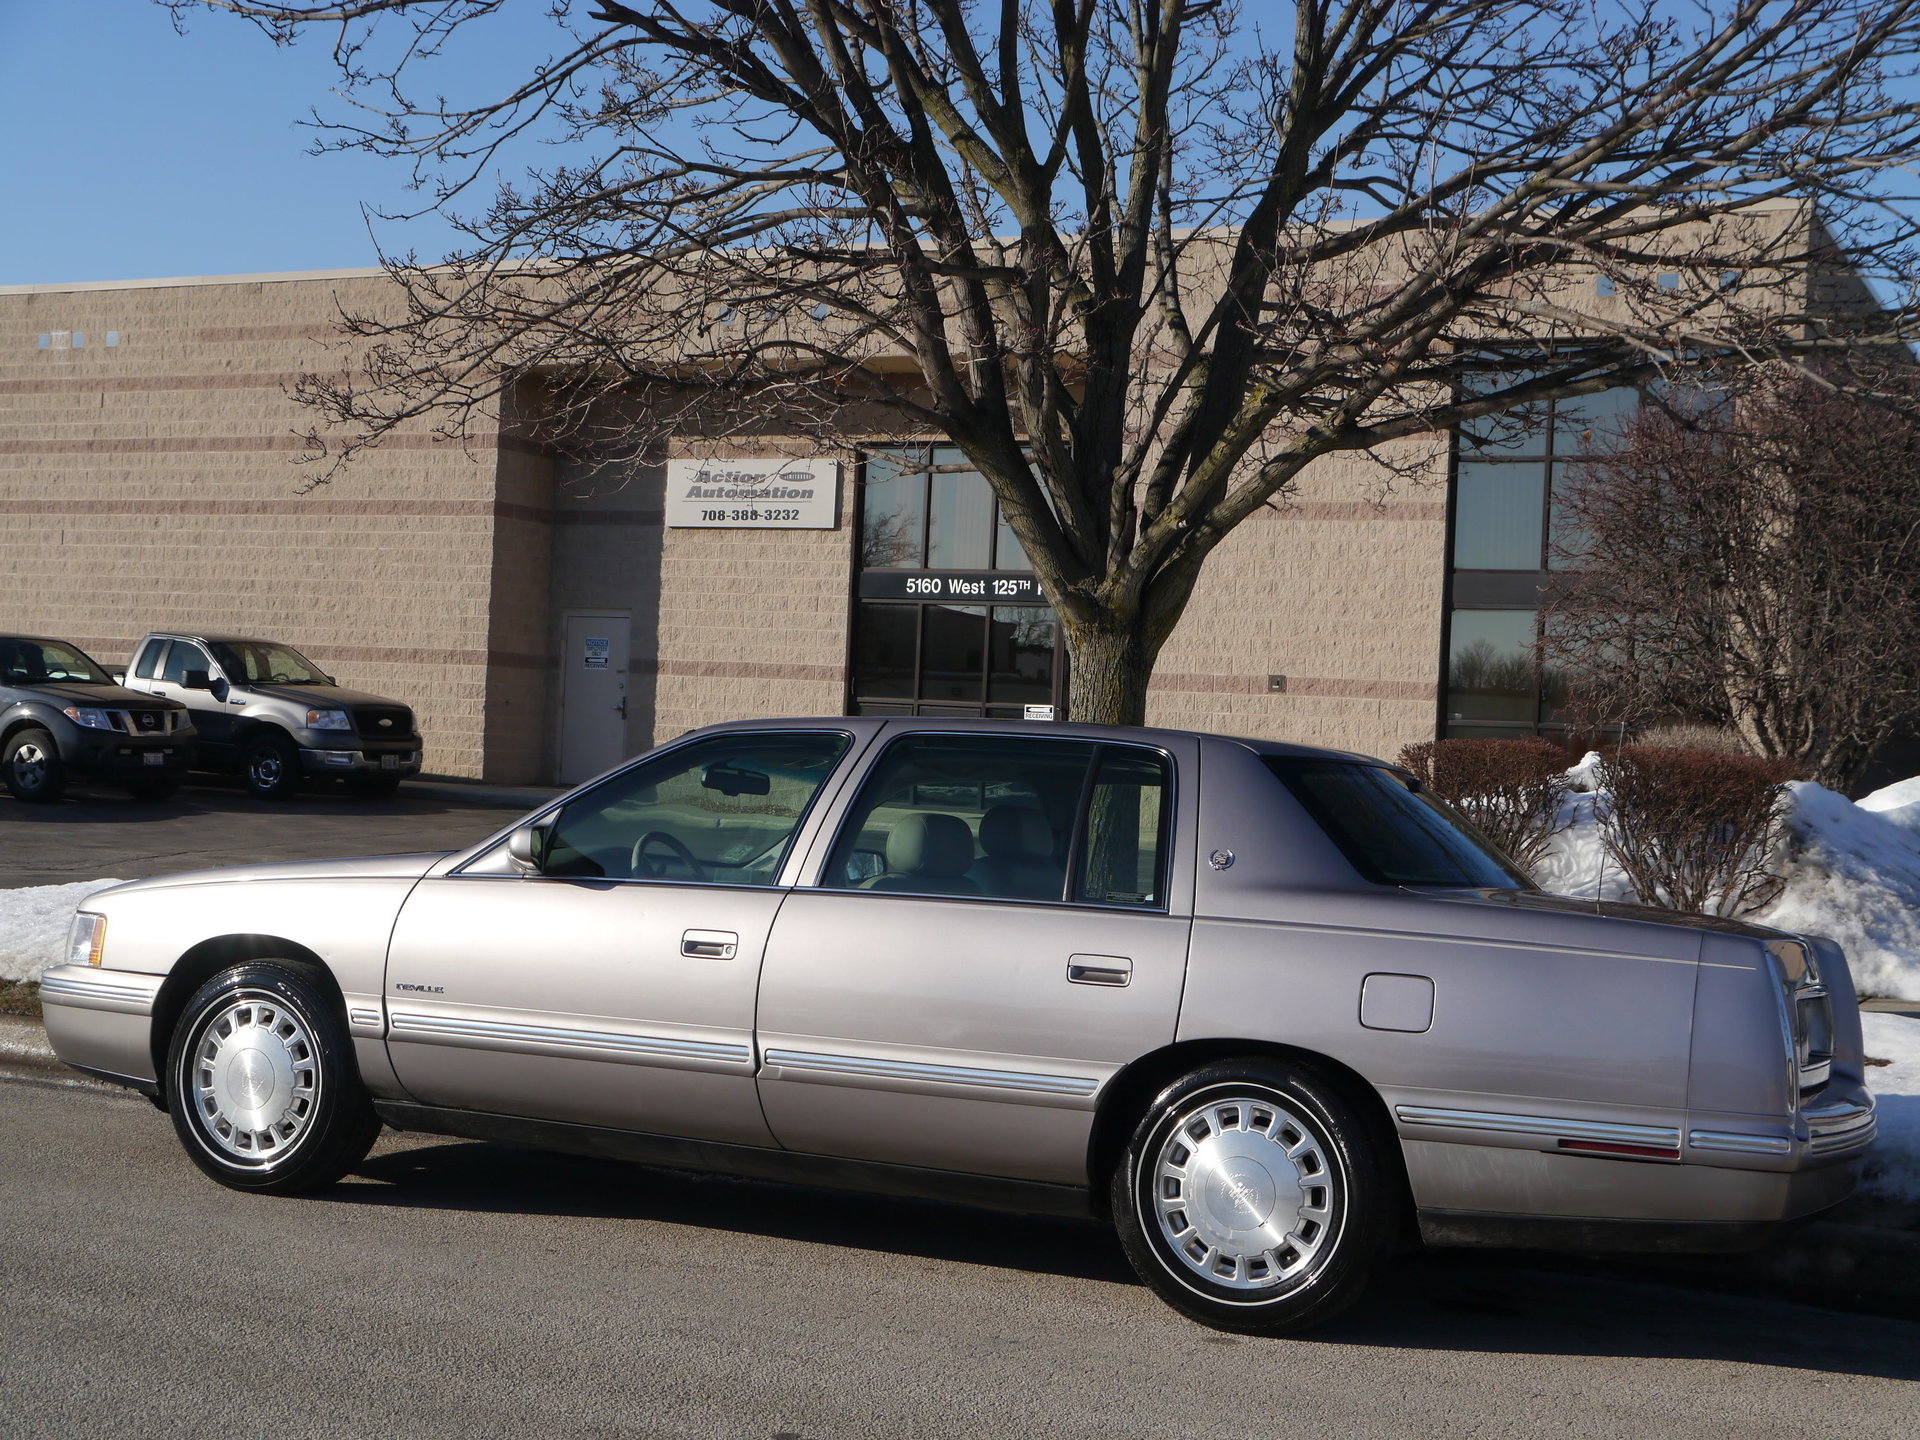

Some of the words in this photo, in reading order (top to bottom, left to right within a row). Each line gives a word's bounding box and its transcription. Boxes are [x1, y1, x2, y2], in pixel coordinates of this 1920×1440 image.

[695, 470, 766, 483] Action
[686, 485, 814, 499] Automation
[701, 509, 800, 521] 708-388-3232
[906, 578, 942, 593] 5160
[949, 579, 985, 595] West
[992, 580, 1031, 595] 125TH
